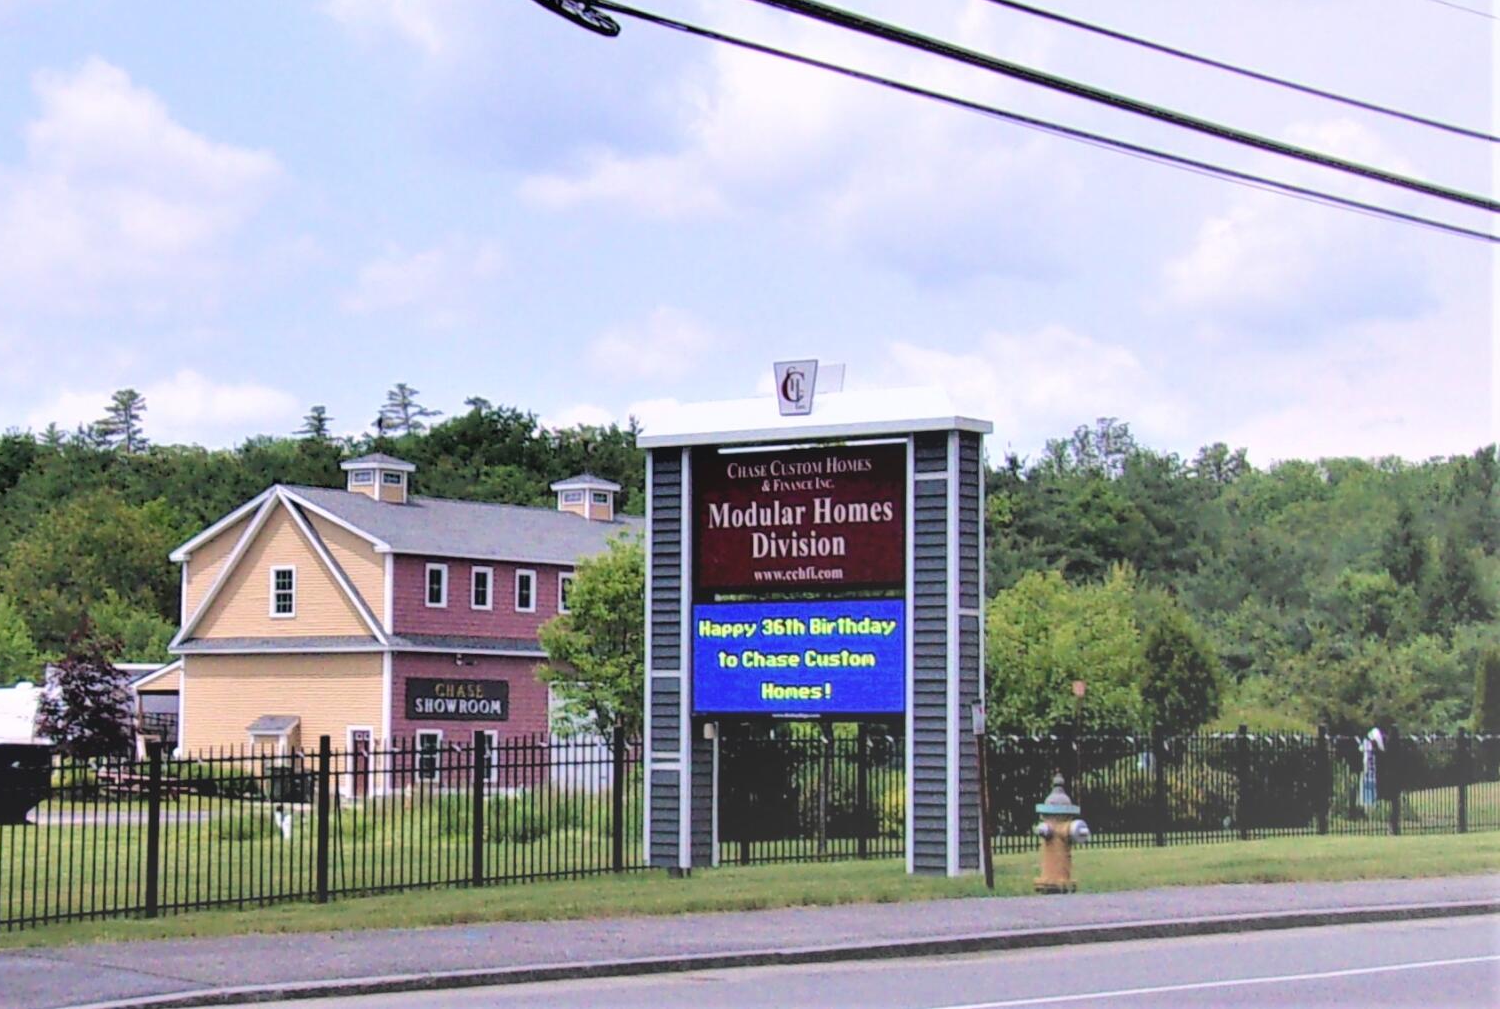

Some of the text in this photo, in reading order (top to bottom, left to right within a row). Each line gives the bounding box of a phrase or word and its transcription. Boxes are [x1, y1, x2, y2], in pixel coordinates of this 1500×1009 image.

[727, 456, 872, 479] CHASE CUSTOM HOMES
[761, 479, 771, 492] &
[773, 478, 813, 492] FINANCE
[708, 497, 894, 529] Modular Homes
[752, 530, 846, 559] Division
[699, 617, 896, 637] Happy 36th Birthday
[718, 650, 876, 668] to Chase Custom
[435, 683, 484, 698] CHASE
[761, 682, 832, 700] Homes!
[415, 697, 502, 714] SHOWROOM
